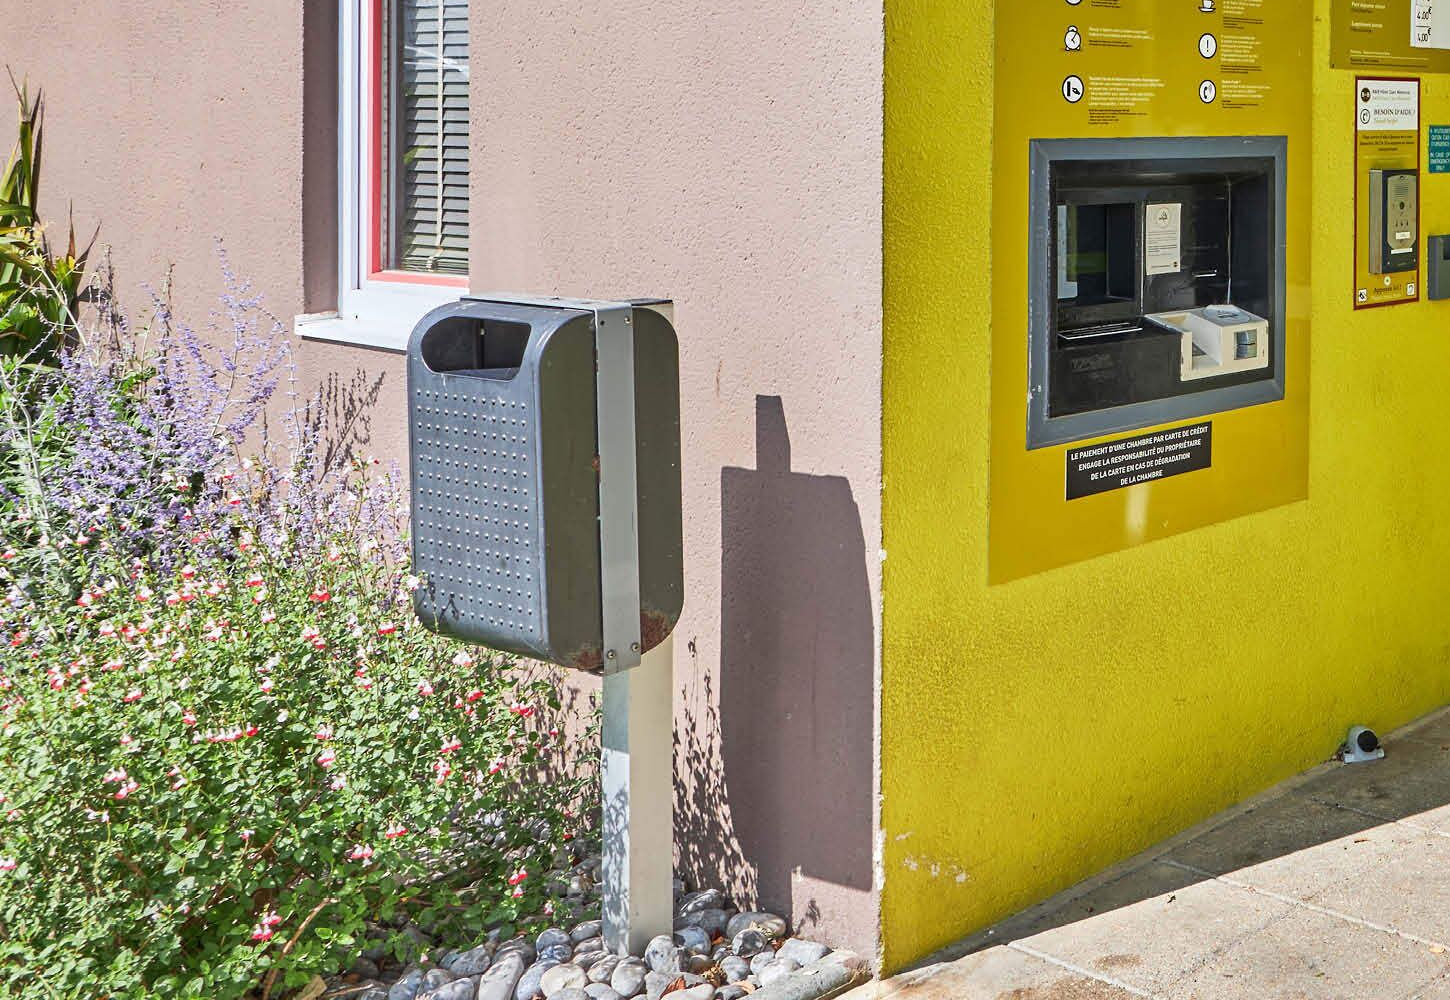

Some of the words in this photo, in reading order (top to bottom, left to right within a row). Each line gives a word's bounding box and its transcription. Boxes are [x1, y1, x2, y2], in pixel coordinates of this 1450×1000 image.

[1373, 108, 1394, 116] BESOIN
[1070, 453, 1079, 461] LE
[1079, 446, 1109, 459] PAIEMENT
[1108, 443, 1126, 453] D'UNE
[1126, 437, 1153, 450] CHAMBRE
[1153, 435, 1165, 444] PAR
[1165, 431, 1183, 442] CARTE
[1182, 429, 1190, 437] DE
[1190, 425, 1209, 436] CRÉDIT
[1078, 460, 1102, 471] ENGAGE
[1102, 457, 1111, 466] LA
[1110, 448, 1156, 464] RESPONSABILITÉ
[1156, 446, 1164, 454] DU
[1165, 438, 1201, 453] PROPRIÉTAIRE
[1090, 473, 1099, 481] DE
[1099, 470, 1108, 479] LA
[1108, 466, 1126, 477] CARTE
[1126, 464, 1135, 472] EN
[1135, 462, 1146, 471] CAS
[1146, 460, 1154, 468] DE
[1154, 451, 1191, 466] DÉGRADATION
[1120, 477, 1128, 486] DE
[1128, 475, 1137, 484] LA
[1136, 469, 1163, 483] CHAMBRE
